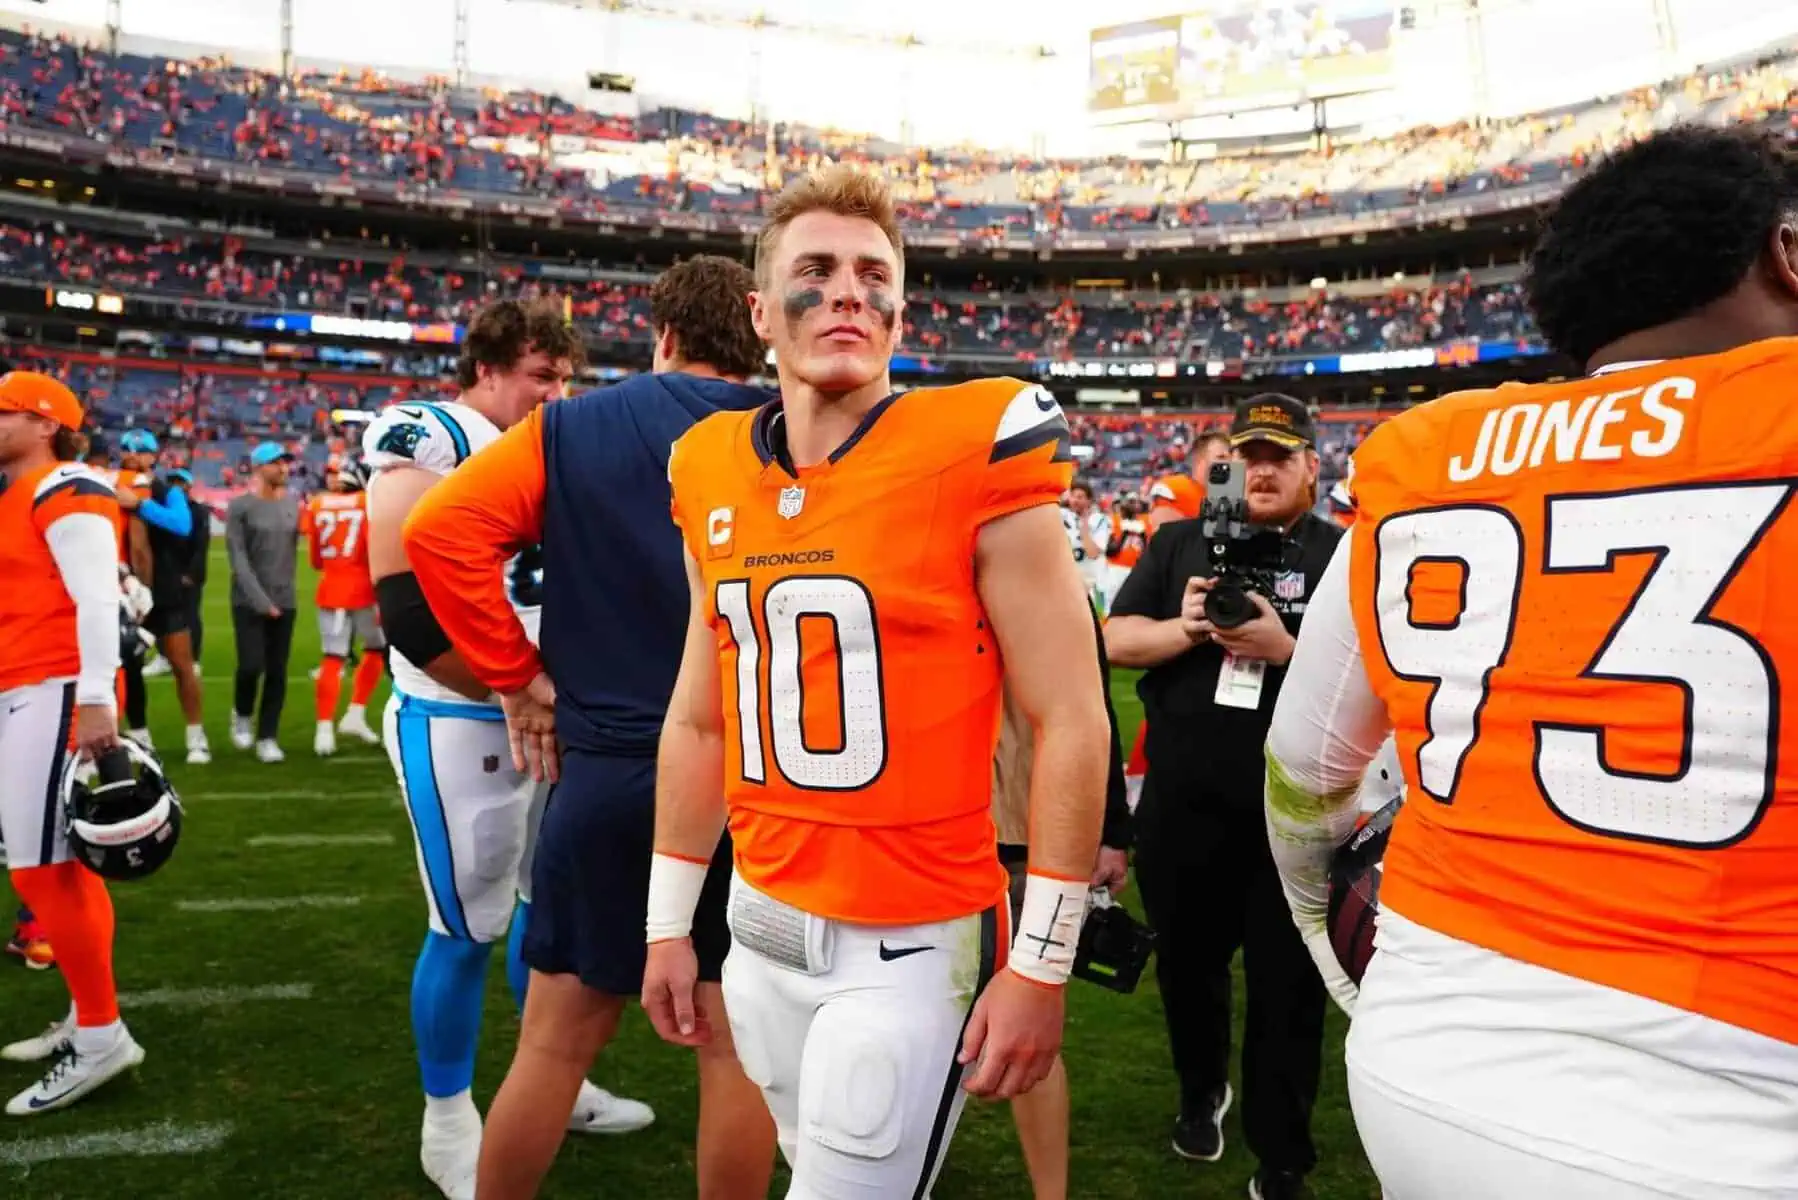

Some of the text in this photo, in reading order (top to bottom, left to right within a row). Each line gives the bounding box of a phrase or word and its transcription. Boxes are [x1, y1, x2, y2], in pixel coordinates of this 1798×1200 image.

[1448, 377, 1695, 481] JONES
[315, 510, 364, 559] 27
[708, 507, 731, 543] C
[744, 549, 834, 568] BRONCOS
[716, 575, 888, 792] 10
[1375, 479, 1796, 848] 93
